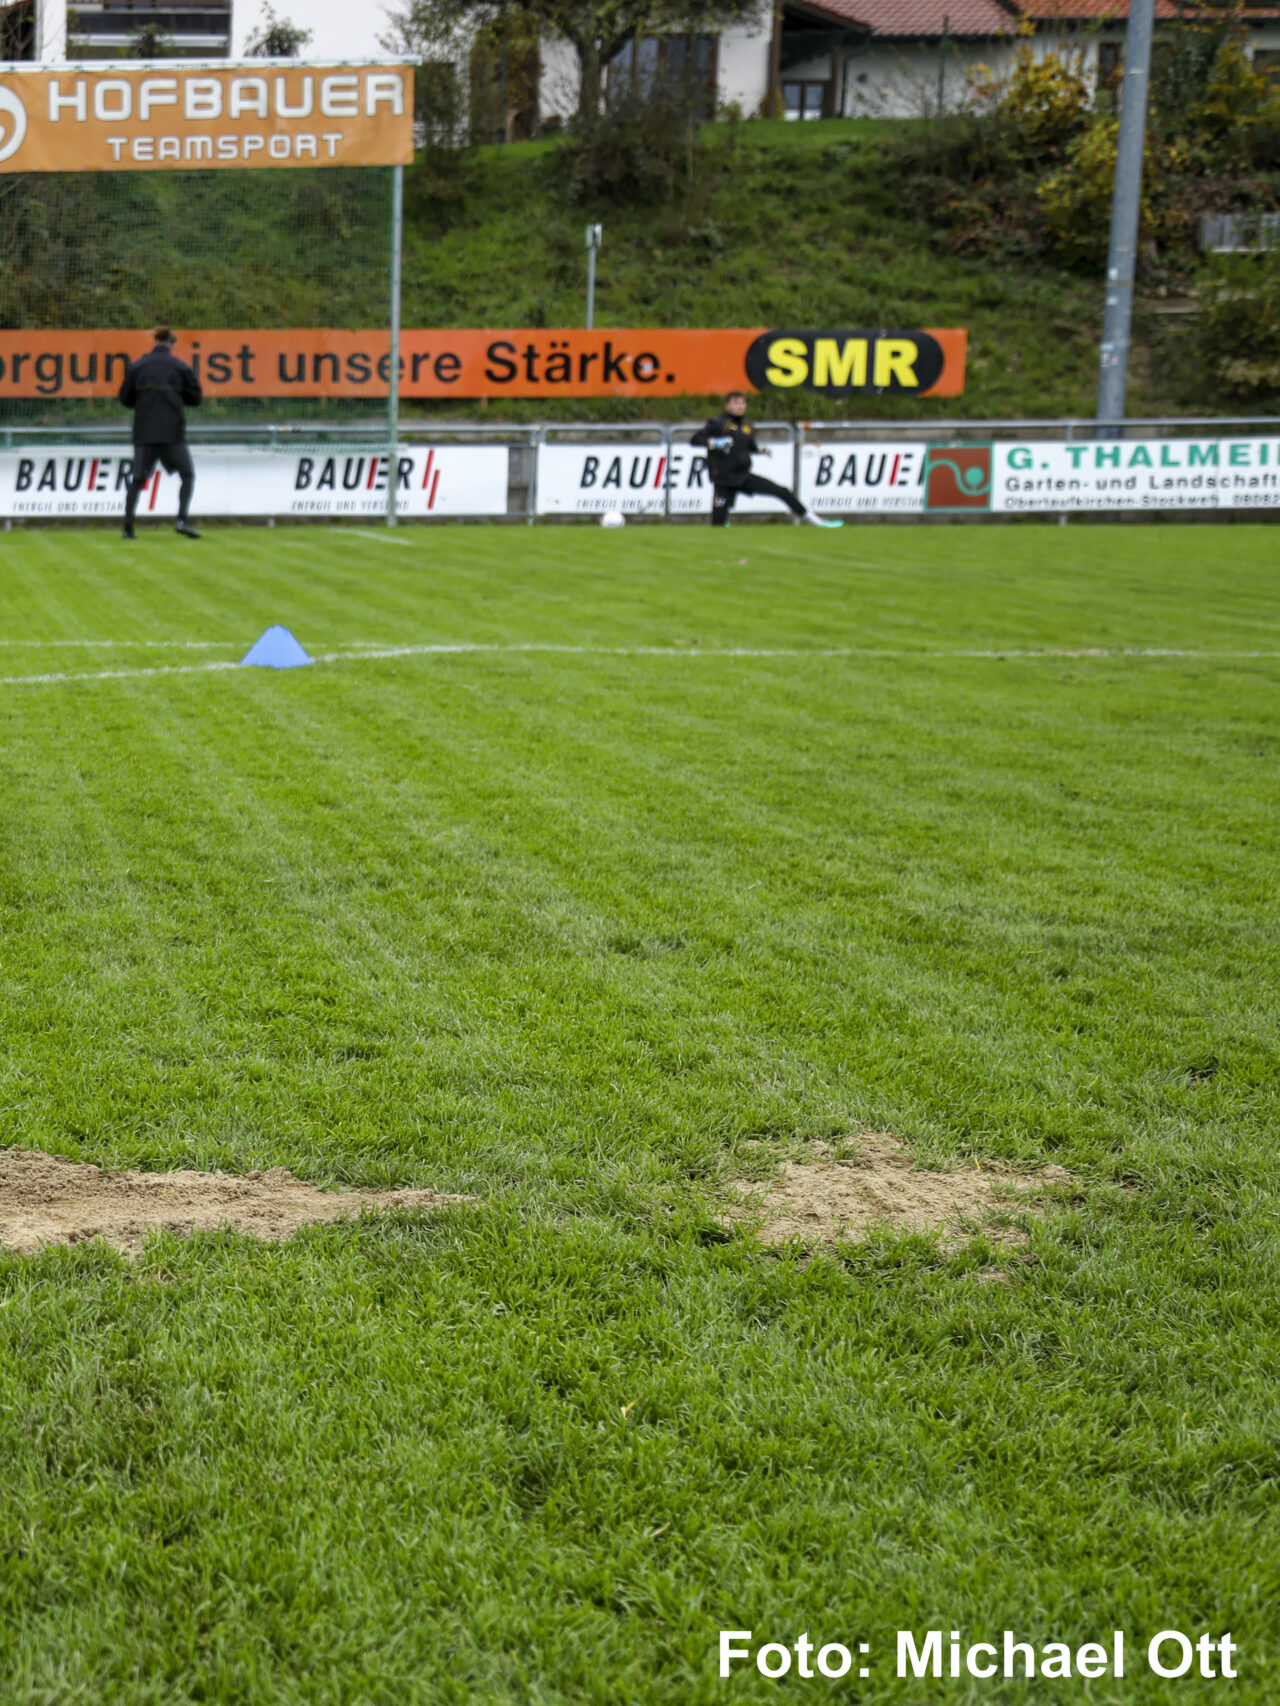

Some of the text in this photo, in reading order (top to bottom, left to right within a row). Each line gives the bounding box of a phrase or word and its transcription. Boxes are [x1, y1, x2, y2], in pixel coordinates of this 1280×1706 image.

[48, 73, 404, 122] HOFBAUER
[107, 132, 343, 161] TEAMSPORT
[192, 342, 255, 383] ist
[279, 350, 463, 383] unsere
[485, 341, 675, 384] Stärke.
[766, 339, 919, 388] SMR
[580, 456, 709, 488] BAUER
[1007, 444, 1280, 469] G. THALMEI
[15, 459, 135, 491] BAUER
[295, 458, 415, 490] BAUER
[1005, 474, 1280, 492] Garten- und Landschaft
[58, 502, 78, 512] UND
[83, 502, 127, 512] VERSTAN
[337, 500, 357, 510] UND
